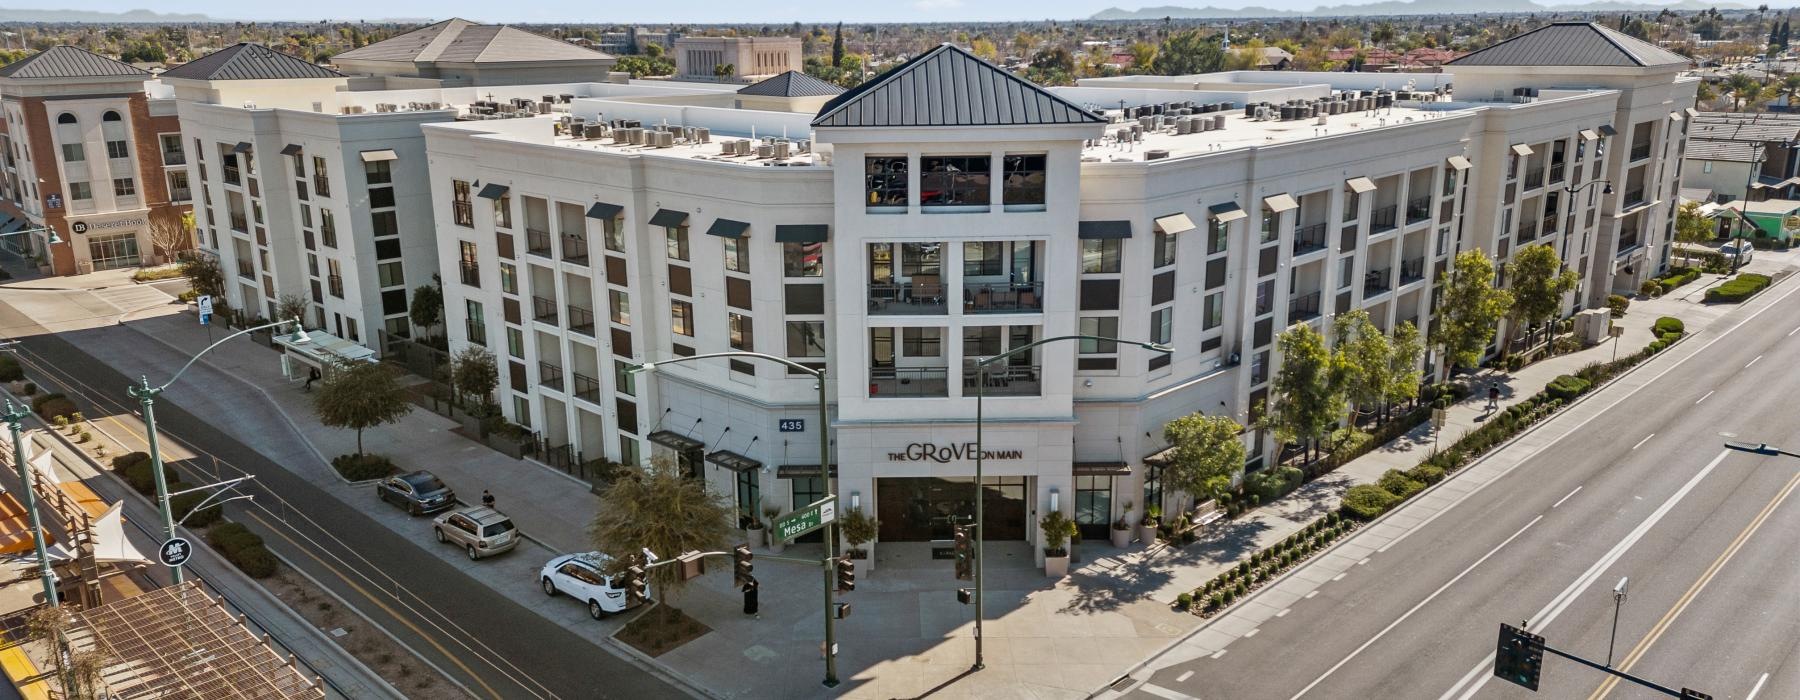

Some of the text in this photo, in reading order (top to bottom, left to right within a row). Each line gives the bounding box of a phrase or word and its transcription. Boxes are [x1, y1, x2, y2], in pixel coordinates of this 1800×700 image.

[781, 421, 802, 430] 435
[888, 452, 906, 461] THE
[979, 451, 995, 460] ON
[997, 450, 1023, 460] MAIN
[784, 521, 806, 537] Mesa
